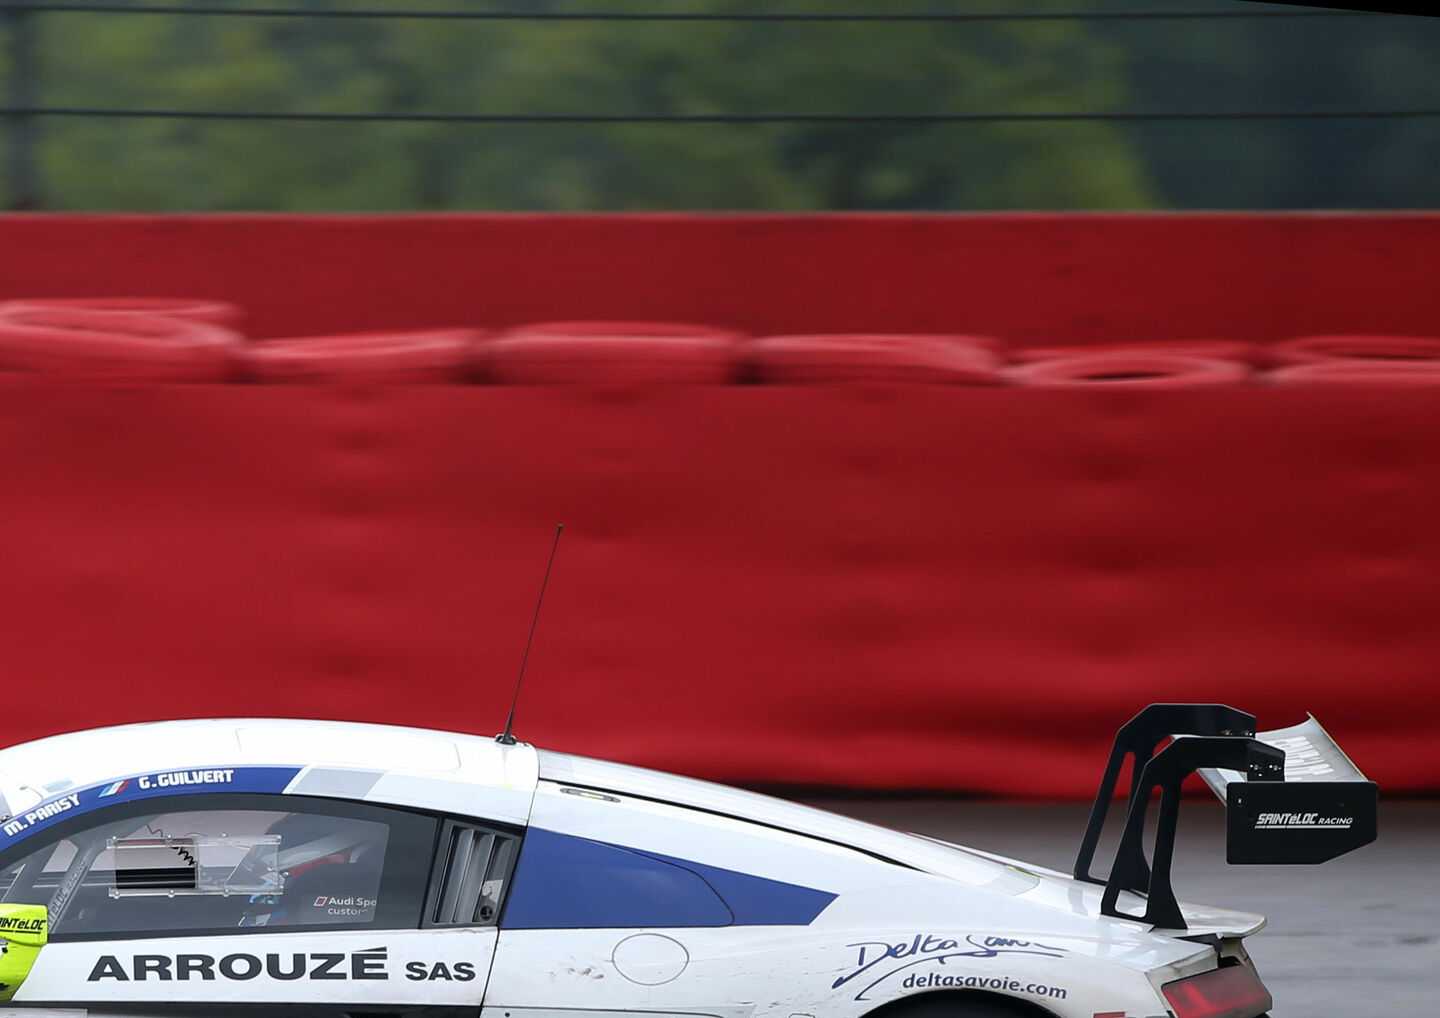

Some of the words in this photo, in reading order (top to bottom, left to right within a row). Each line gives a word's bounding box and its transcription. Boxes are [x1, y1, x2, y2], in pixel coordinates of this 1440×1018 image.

[1318, 817, 1353, 825] RACING
[328, 897, 354, 906] Audi
[87, 947, 389, 981] ARROUZÉ
[405, 962, 476, 981] SAS
[902, 973, 1067, 999] deltasavoie.com
